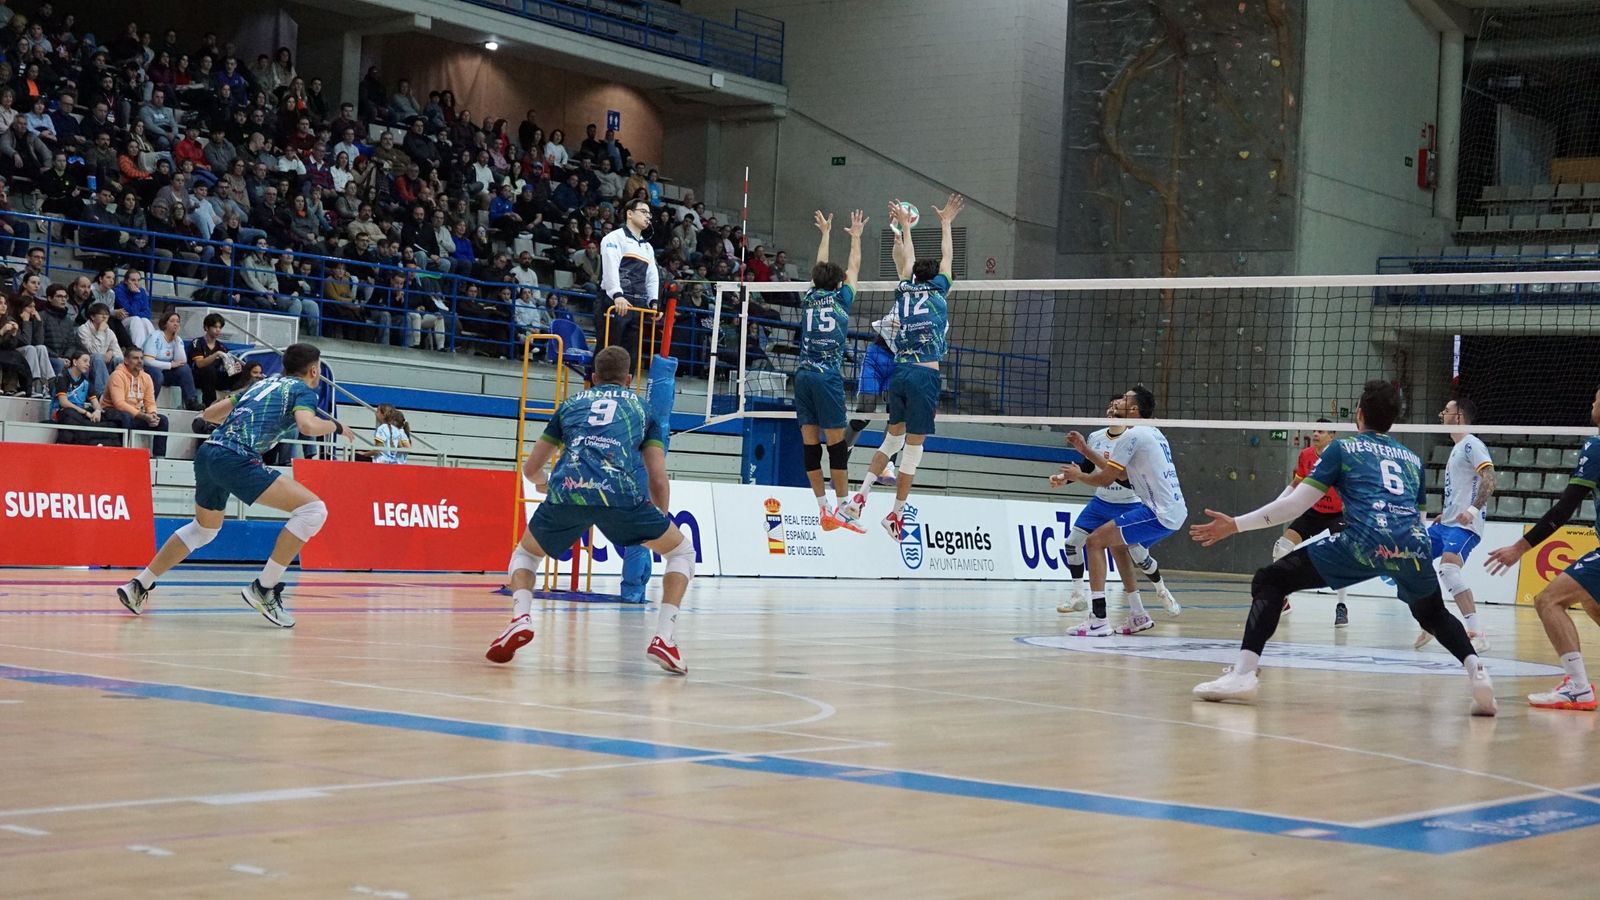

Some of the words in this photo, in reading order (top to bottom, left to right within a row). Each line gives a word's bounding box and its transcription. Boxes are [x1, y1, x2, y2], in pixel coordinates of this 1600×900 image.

[903, 290, 929, 318] 12
[806, 307, 836, 333] 15
[576, 390, 639, 401] VILLALBA
[587, 399, 618, 427] 9
[1344, 440, 1422, 469] WESTERMANN
[1380, 459, 1405, 496] 6
[5, 491, 130, 521] SUPERLIGA
[373, 499, 459, 529] LEGANÉS
[784, 515, 800, 526] REAL
[800, 515, 821, 526] FEDER
[785, 529, 817, 541] ESPAÑOLA
[925, 523, 992, 555] Leganés
[787, 545, 795, 556] DE
[797, 546, 825, 557] VOLEIBOL
[929, 557, 995, 572] AYUNTAMIENTO
